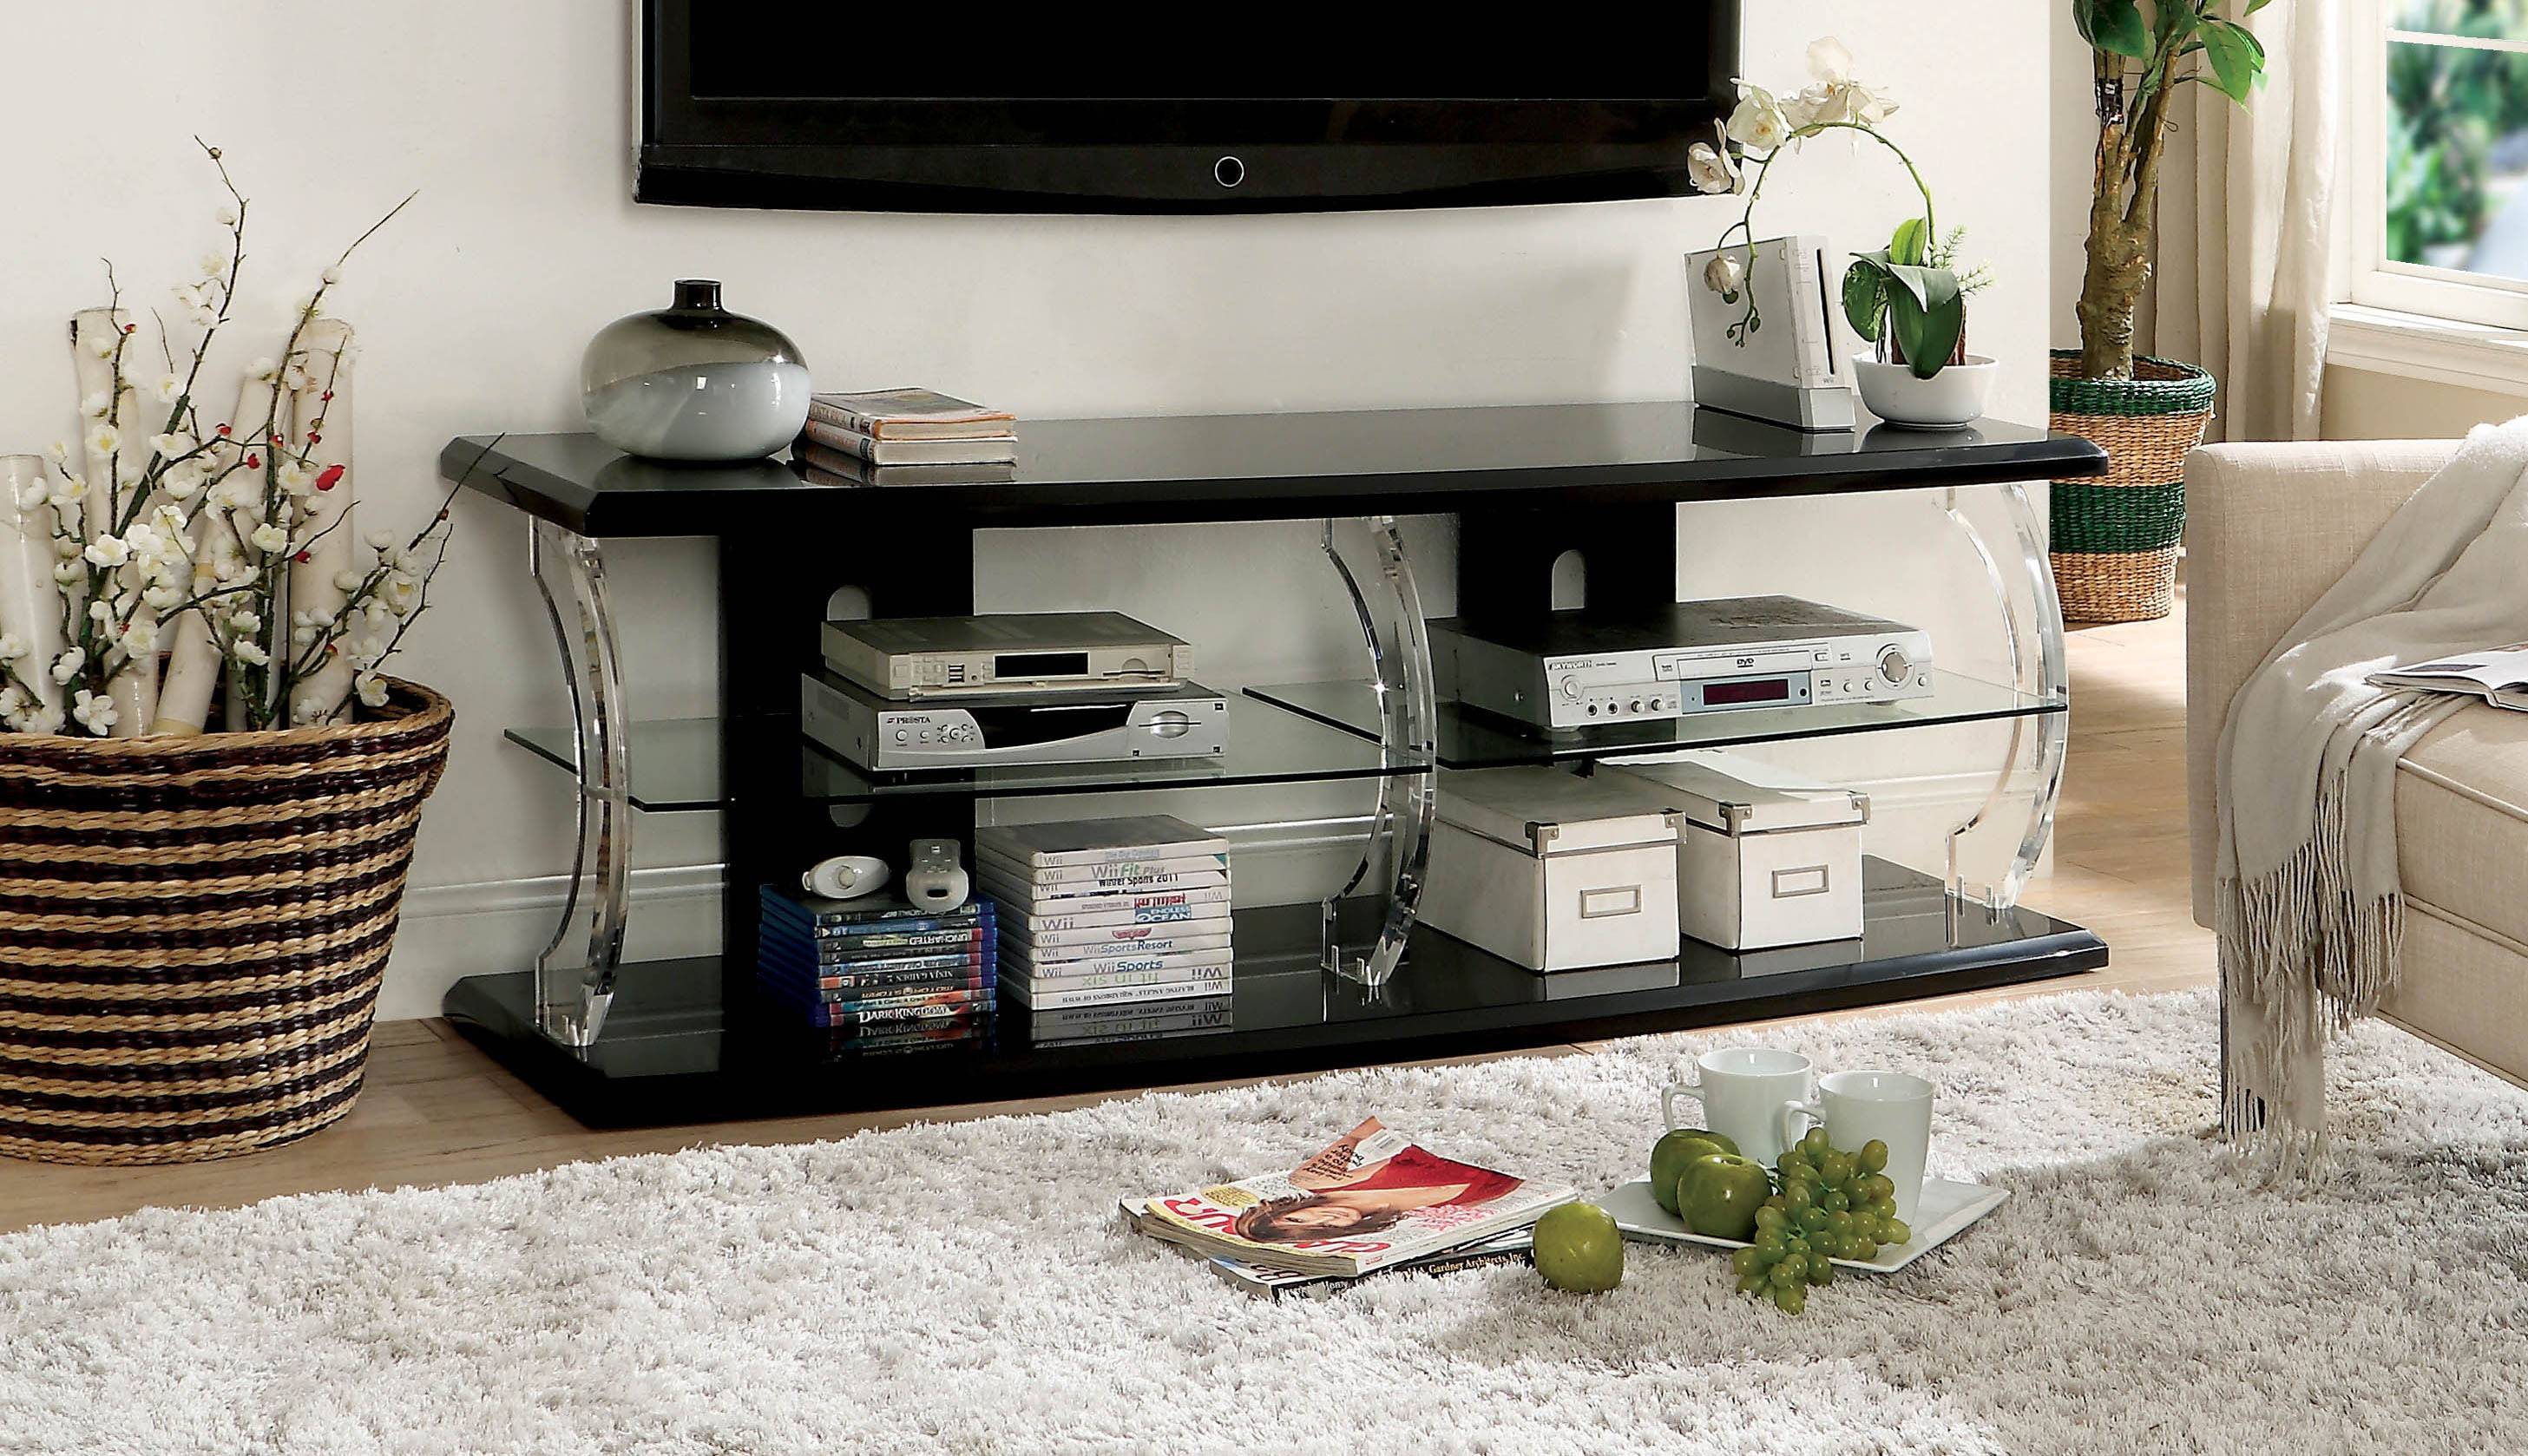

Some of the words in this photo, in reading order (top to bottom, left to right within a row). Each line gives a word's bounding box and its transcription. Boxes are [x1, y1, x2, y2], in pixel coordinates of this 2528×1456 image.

[1737, 658, 1755, 666] DVD
[1043, 856, 1063, 866] Wii
[1043, 869, 1063, 881] Wii
[1143, 866, 1166, 876] Plus
[1098, 877, 1126, 888] Winter
[1127, 874, 1154, 887] Sports
[1156, 873, 1179, 883] 2011
[1041, 916, 1074, 930] Wii
[1136, 911, 1192, 923] OCEAN
[909, 933, 969, 945] UNCHARTED
[1041, 934, 1060, 944] Wii
[1041, 948, 1059, 958] Wii
[1042, 967, 1062, 979] Wii
[1192, 967, 1224, 980] Wii
[1204, 981, 1224, 992] Wii
[858, 1008, 894, 1024] DARK
[895, 1004, 949, 1020] KINGDOM
[1428, 1261, 1464, 1274] Gardner
[1509, 1252, 1526, 1263] Inc.
